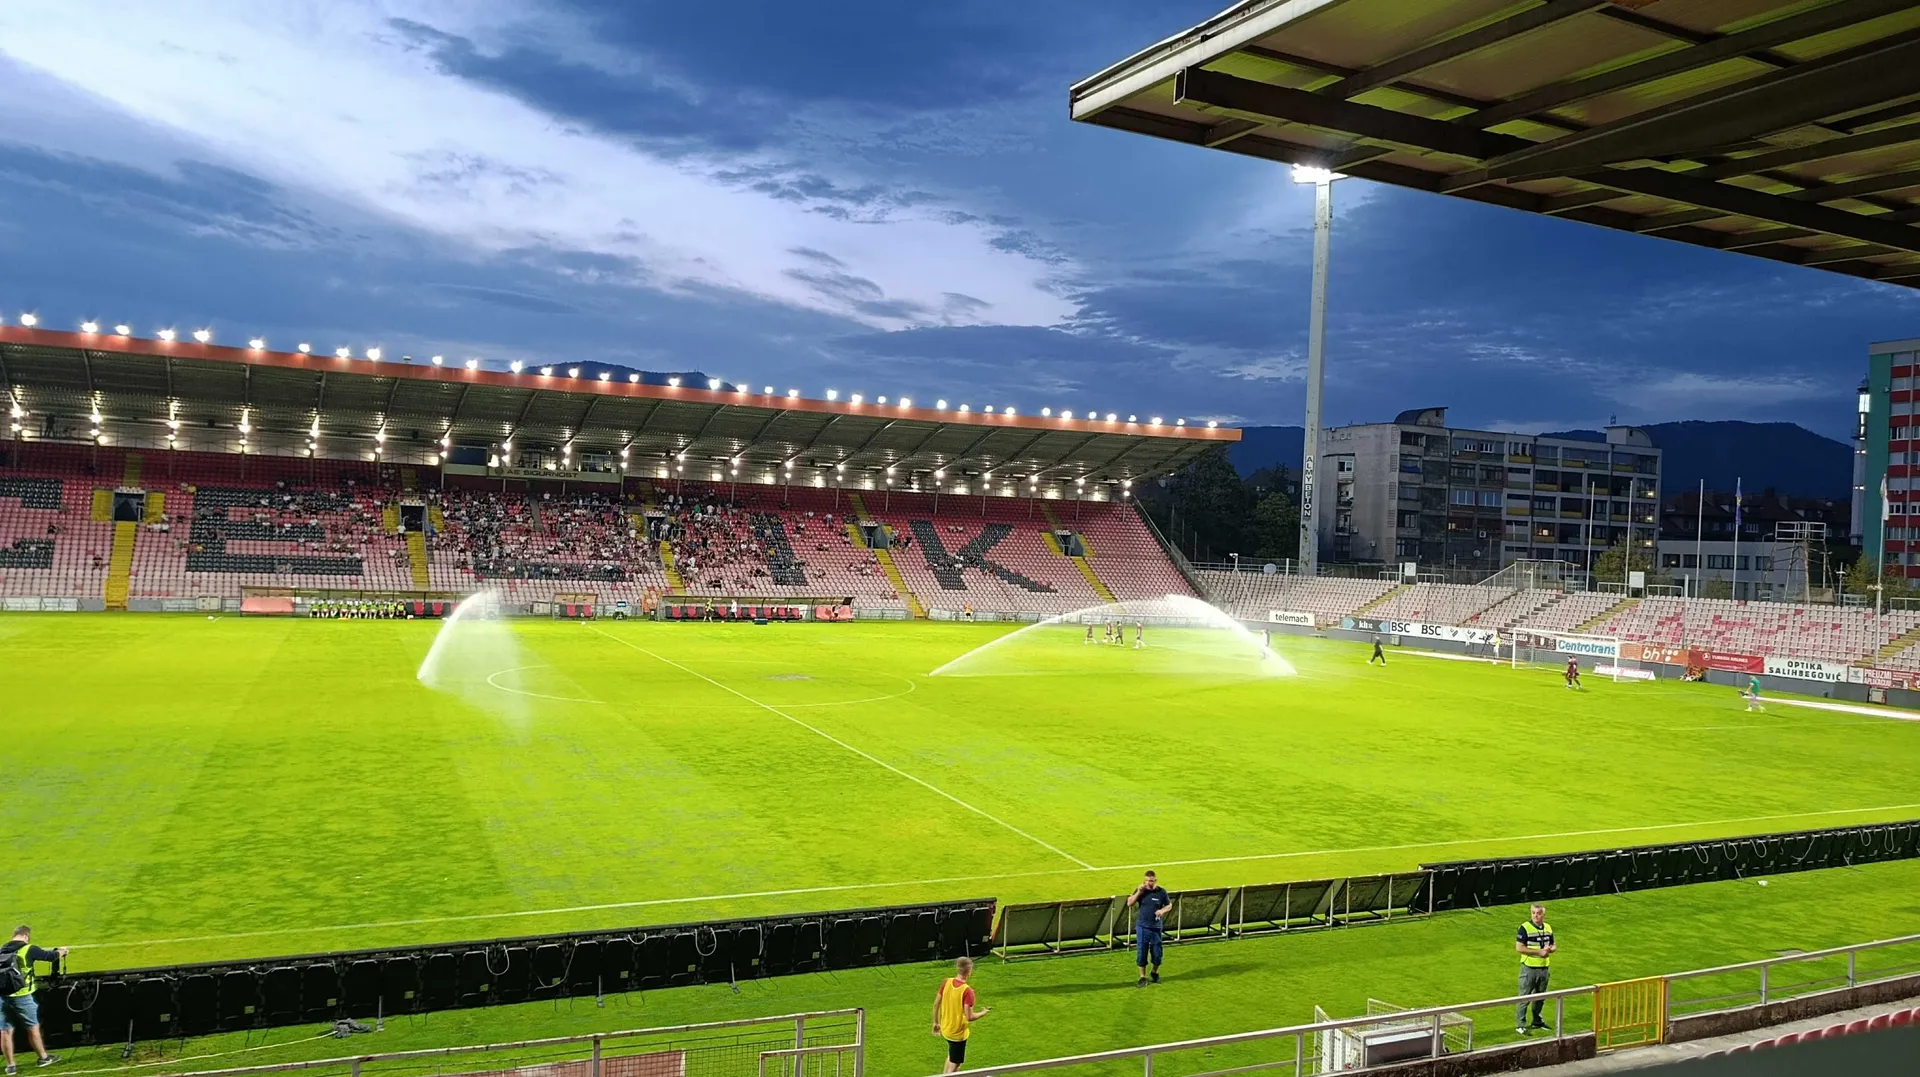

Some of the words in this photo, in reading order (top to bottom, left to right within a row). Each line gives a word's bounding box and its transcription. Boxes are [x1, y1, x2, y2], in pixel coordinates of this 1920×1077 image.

[523, 469, 579, 478] SIGURNOST
[1275, 613, 1309, 623] telemach
[1391, 621, 1411, 633] BSC
[1421, 624, 1442, 636] BSC
[1558, 639, 1616, 656] Centrotrans
[1642, 646, 1660, 660] bh
[1787, 660, 1823, 670] OPTIKA
[1768, 666, 1842, 681] SALIHBEGOVIĆ
